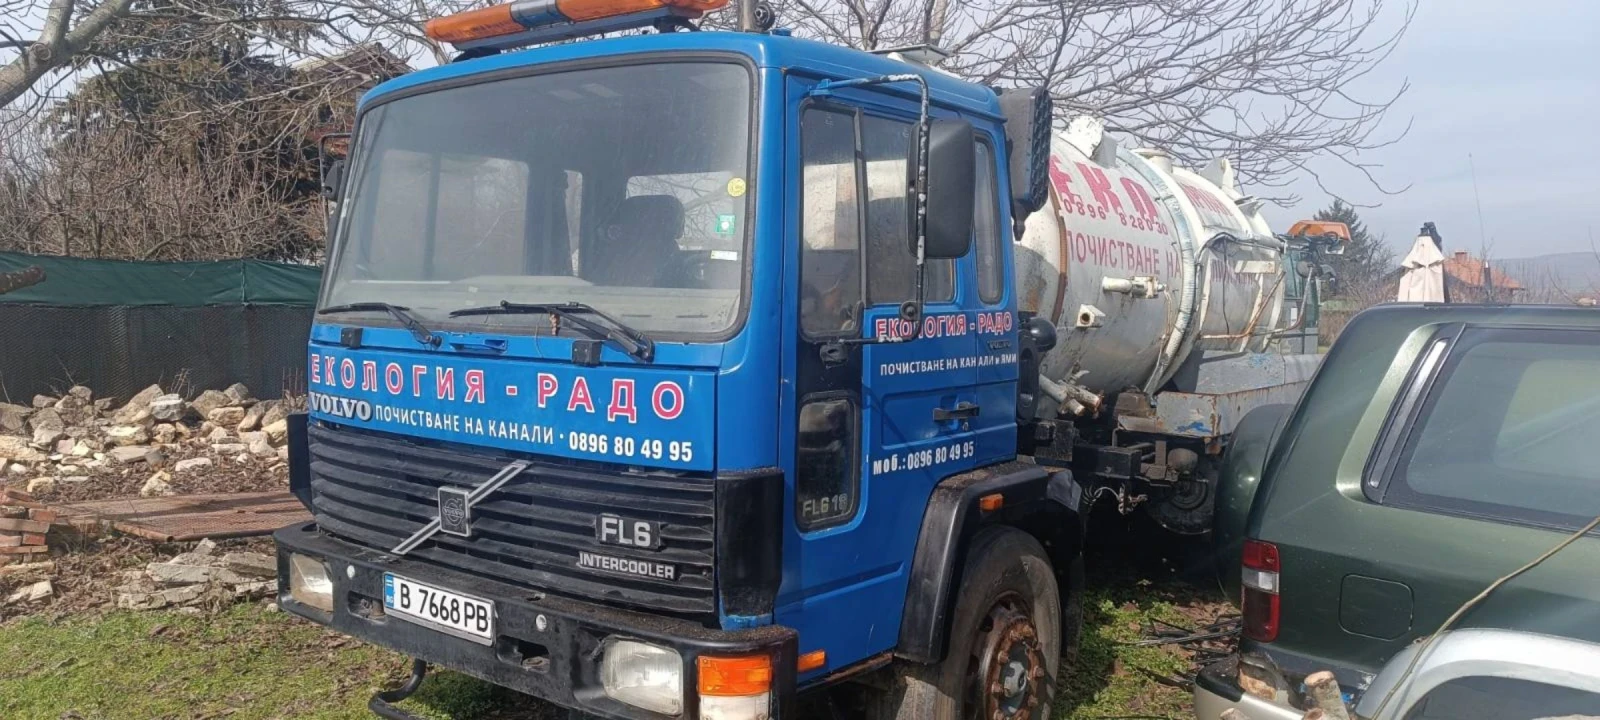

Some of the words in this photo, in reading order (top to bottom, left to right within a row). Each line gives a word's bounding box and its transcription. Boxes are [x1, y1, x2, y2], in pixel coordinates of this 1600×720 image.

[1064, 199, 1106, 220] 0896
[978, 311, 1013, 336] РАДО
[880, 358, 945, 376] ПОЧИСТВАНЕ
[946, 358, 959, 370] НА
[1001, 353, 1017, 364] ЯМИ
[311, 353, 486, 404] ЕКОЛОГИЯ
[505, 385, 518, 396] -
[537, 372, 685, 423] РАДО
[309, 391, 372, 421] VOLVO
[375, 404, 460, 432] ПОЧИСТВАНЕ
[464, 416, 484, 435] НА
[488, 420, 554, 445] КАНАЛИ
[569, 431, 608, 454] 0896
[614, 436, 635, 457] 80
[640, 439, 663, 460] 49
[669, 441, 693, 462] 95
[935, 447, 948, 464] 80
[949, 444, 961, 460] 49
[963, 440, 975, 458] 95
[601, 517, 651, 547] FL6
[579, 552, 675, 580] INTERCOOLER
